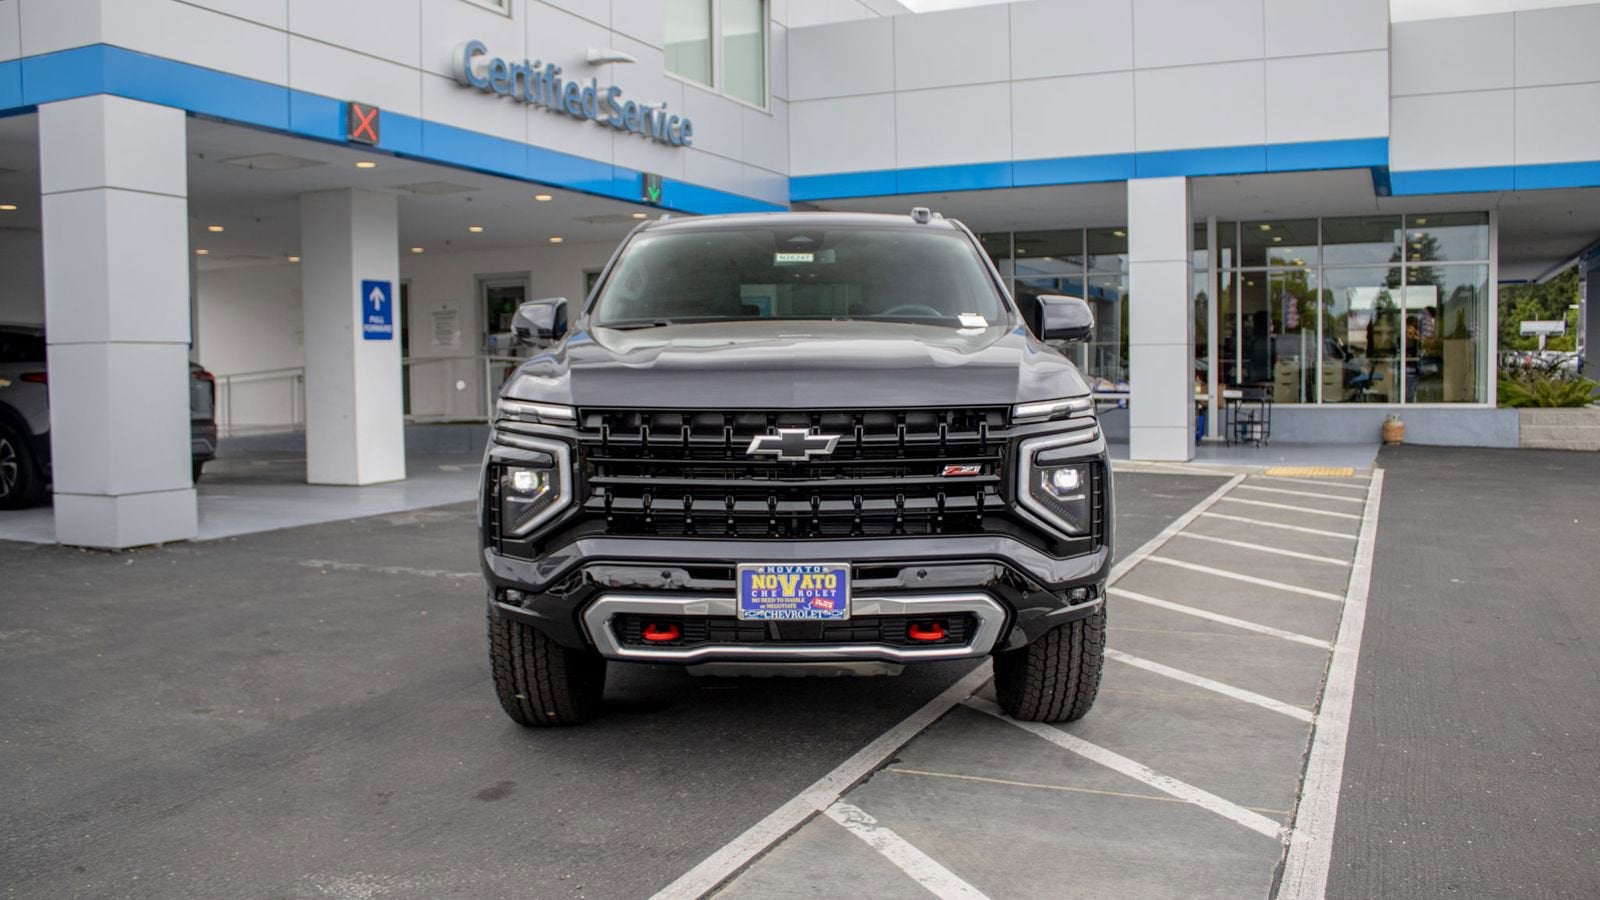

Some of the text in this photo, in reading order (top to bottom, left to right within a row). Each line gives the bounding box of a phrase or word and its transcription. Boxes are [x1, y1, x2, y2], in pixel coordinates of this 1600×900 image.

[463, 39, 694, 147] Certified Service
[767, 566, 821, 574] NOVATO
[751, 574, 837, 597] NOVATO
[764, 609, 823, 619] CHEVROLET
